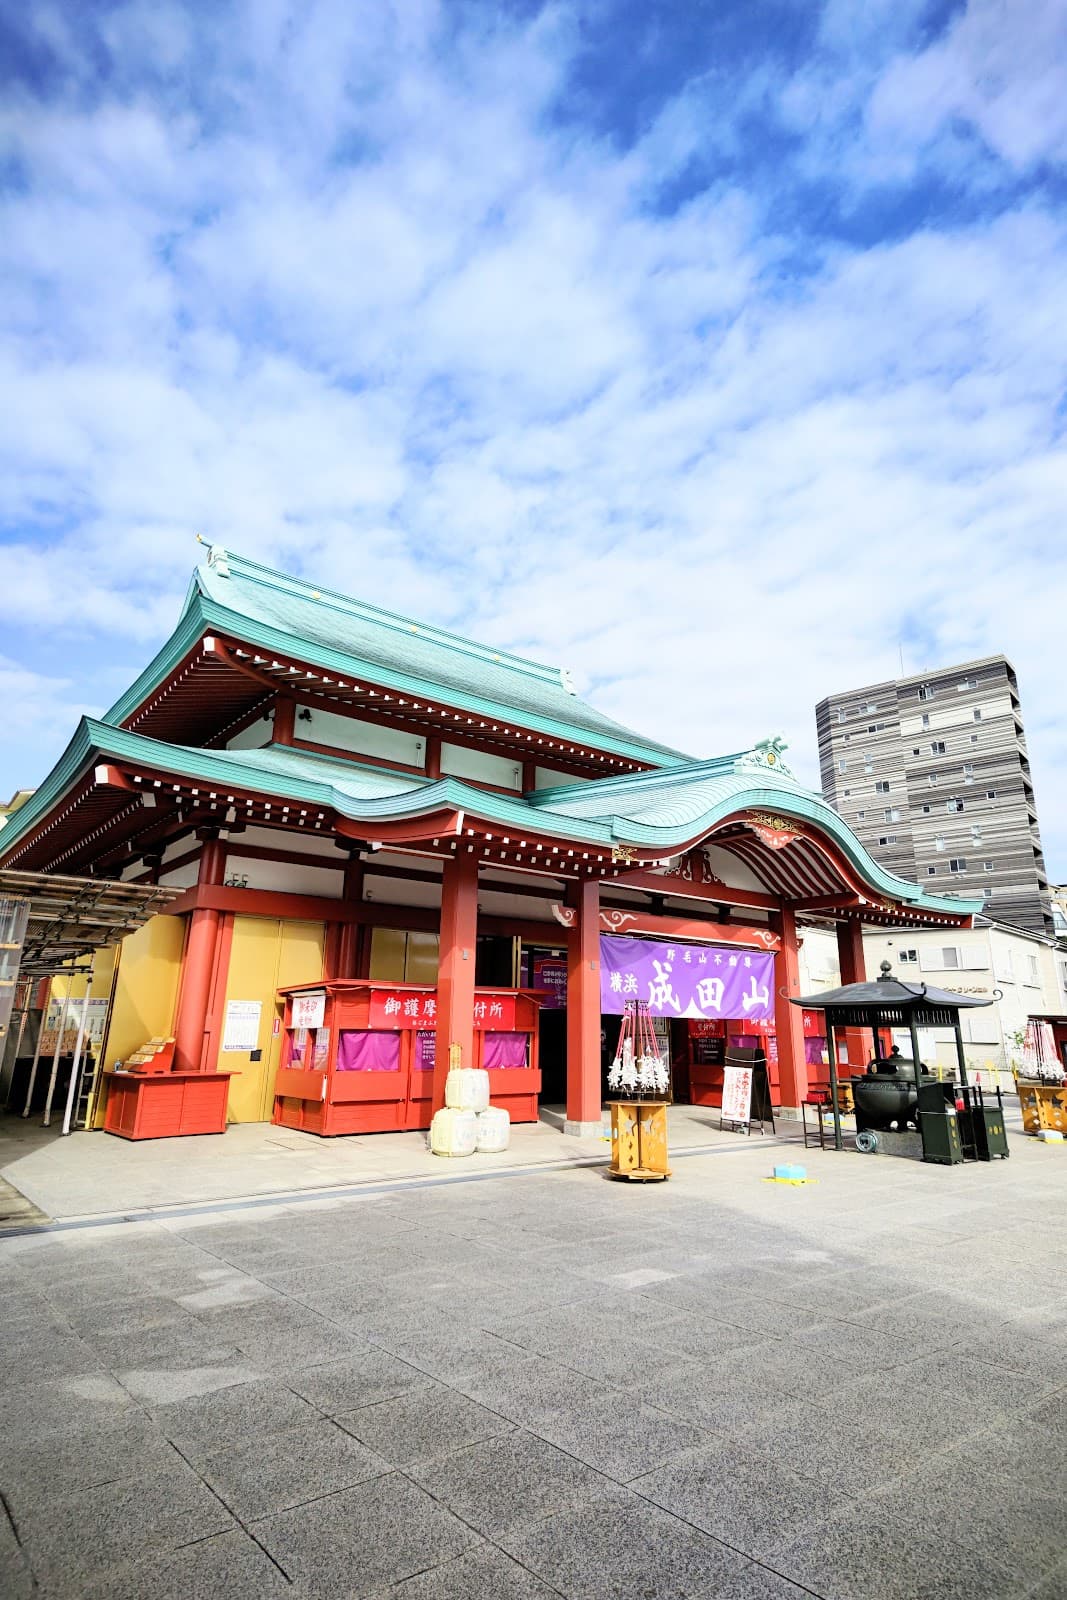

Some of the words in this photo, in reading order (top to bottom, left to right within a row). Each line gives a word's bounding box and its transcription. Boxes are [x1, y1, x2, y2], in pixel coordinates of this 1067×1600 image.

[609, 971, 639, 995] 横浜
[647, 959, 770, 1013] 成田山
